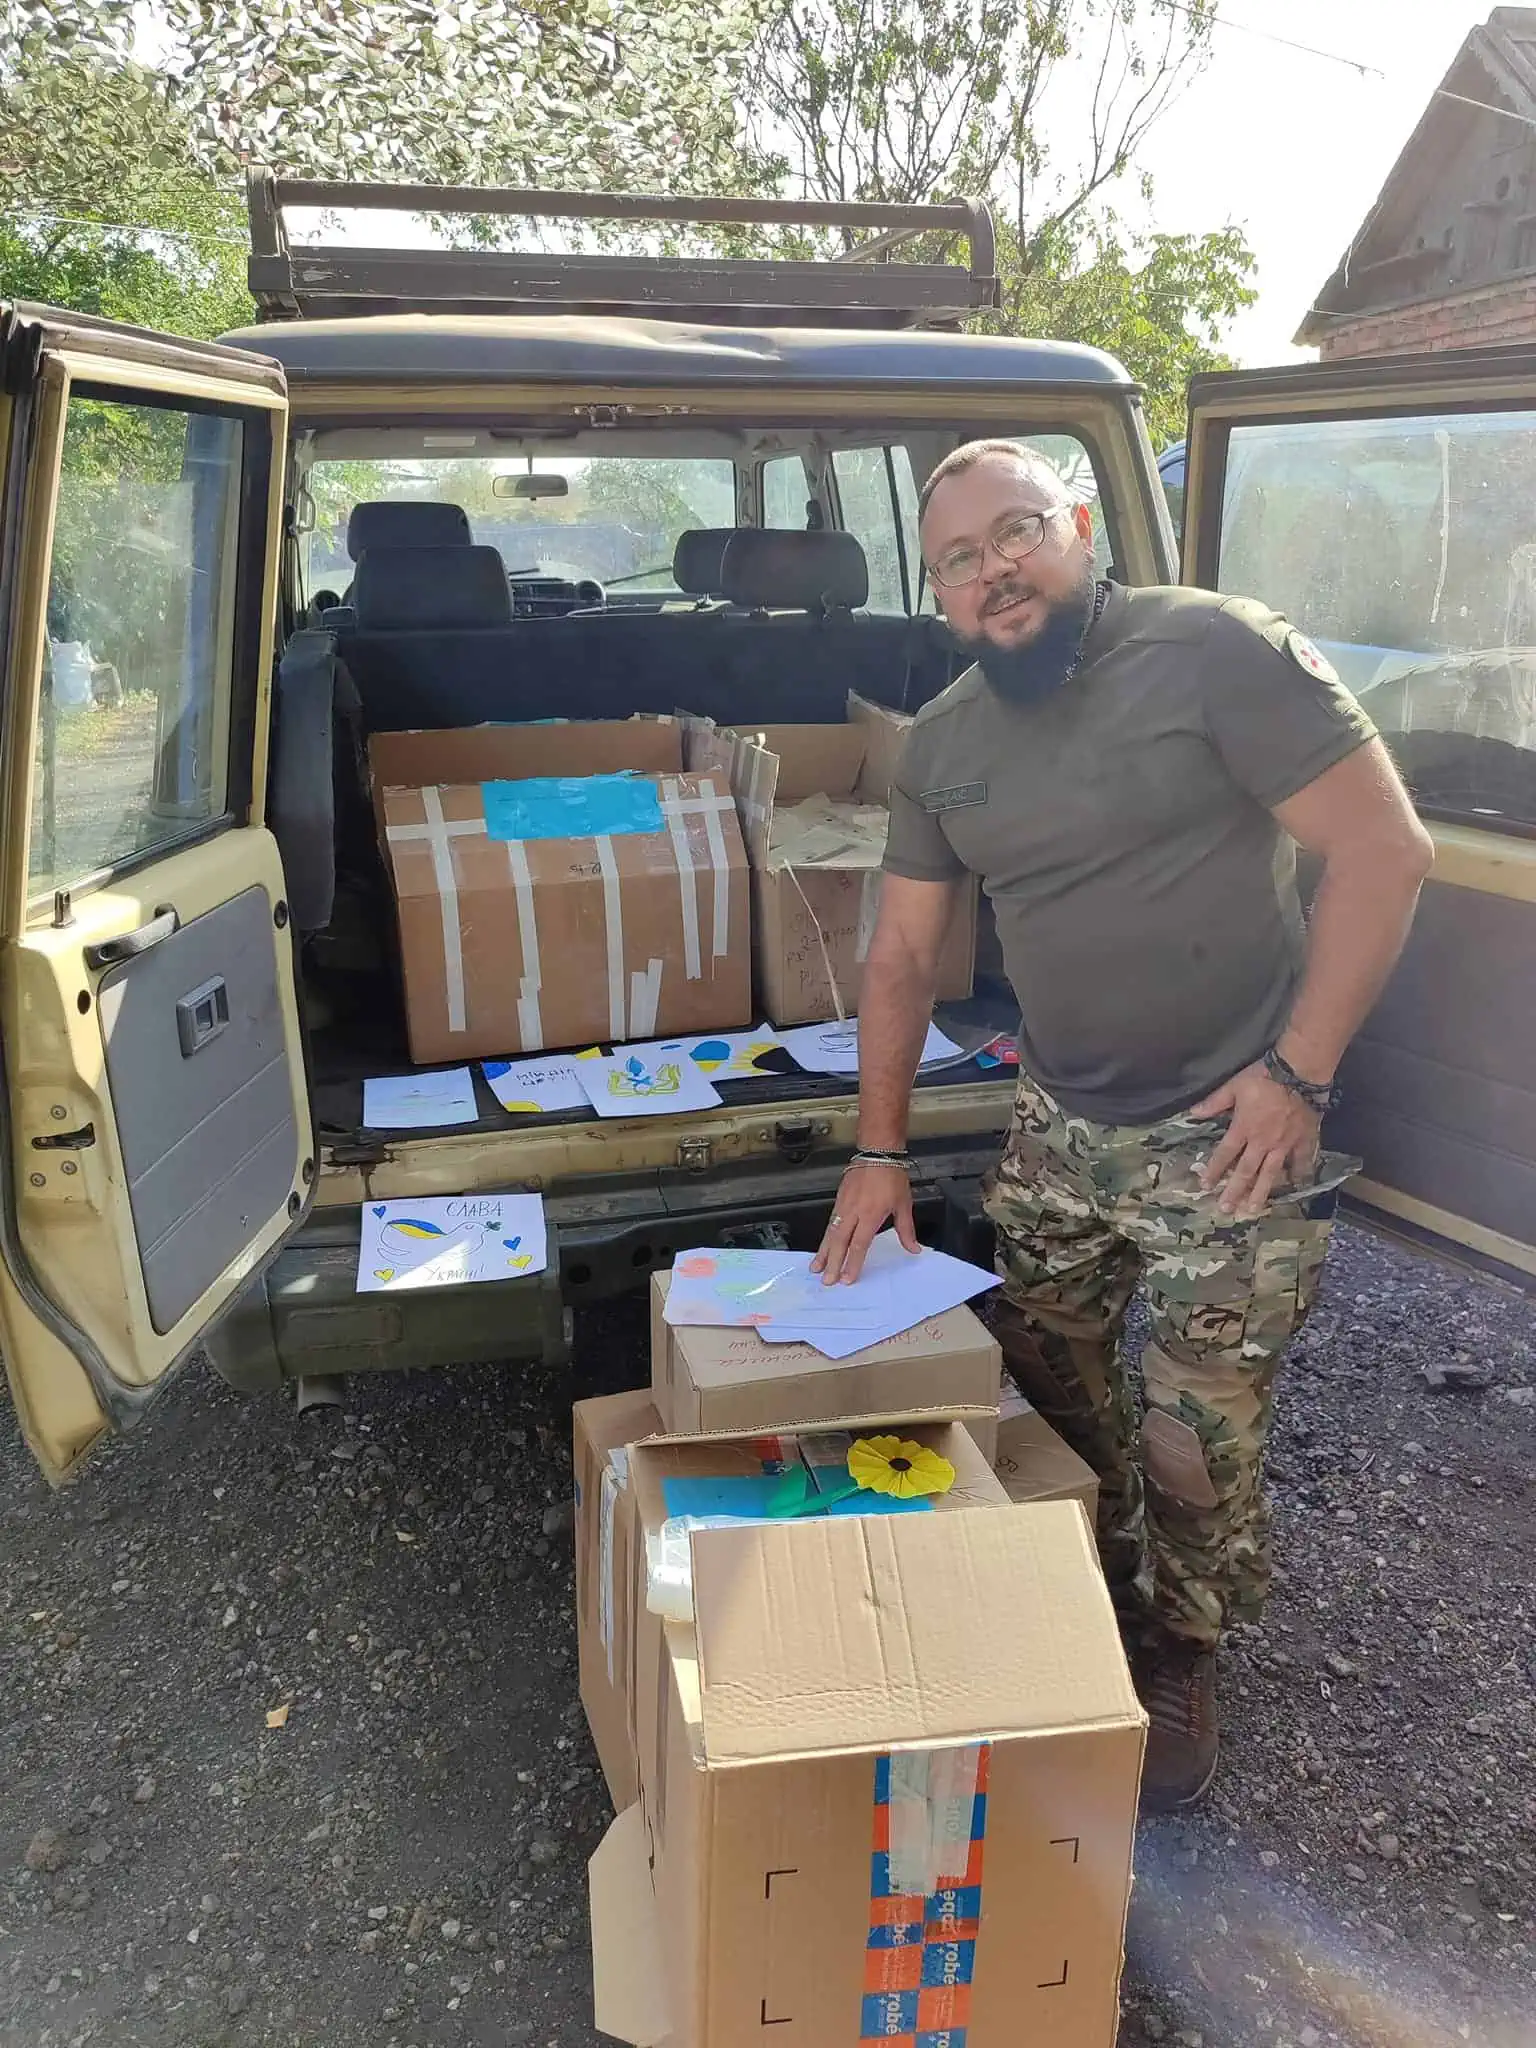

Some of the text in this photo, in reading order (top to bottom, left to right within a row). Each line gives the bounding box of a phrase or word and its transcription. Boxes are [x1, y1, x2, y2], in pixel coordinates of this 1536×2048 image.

[446, 1200, 504, 1217] СЛАВА
[943, 1942, 960, 1985] robé
[885, 1992, 903, 2033] robé
[937, 2031, 951, 2048] ro
